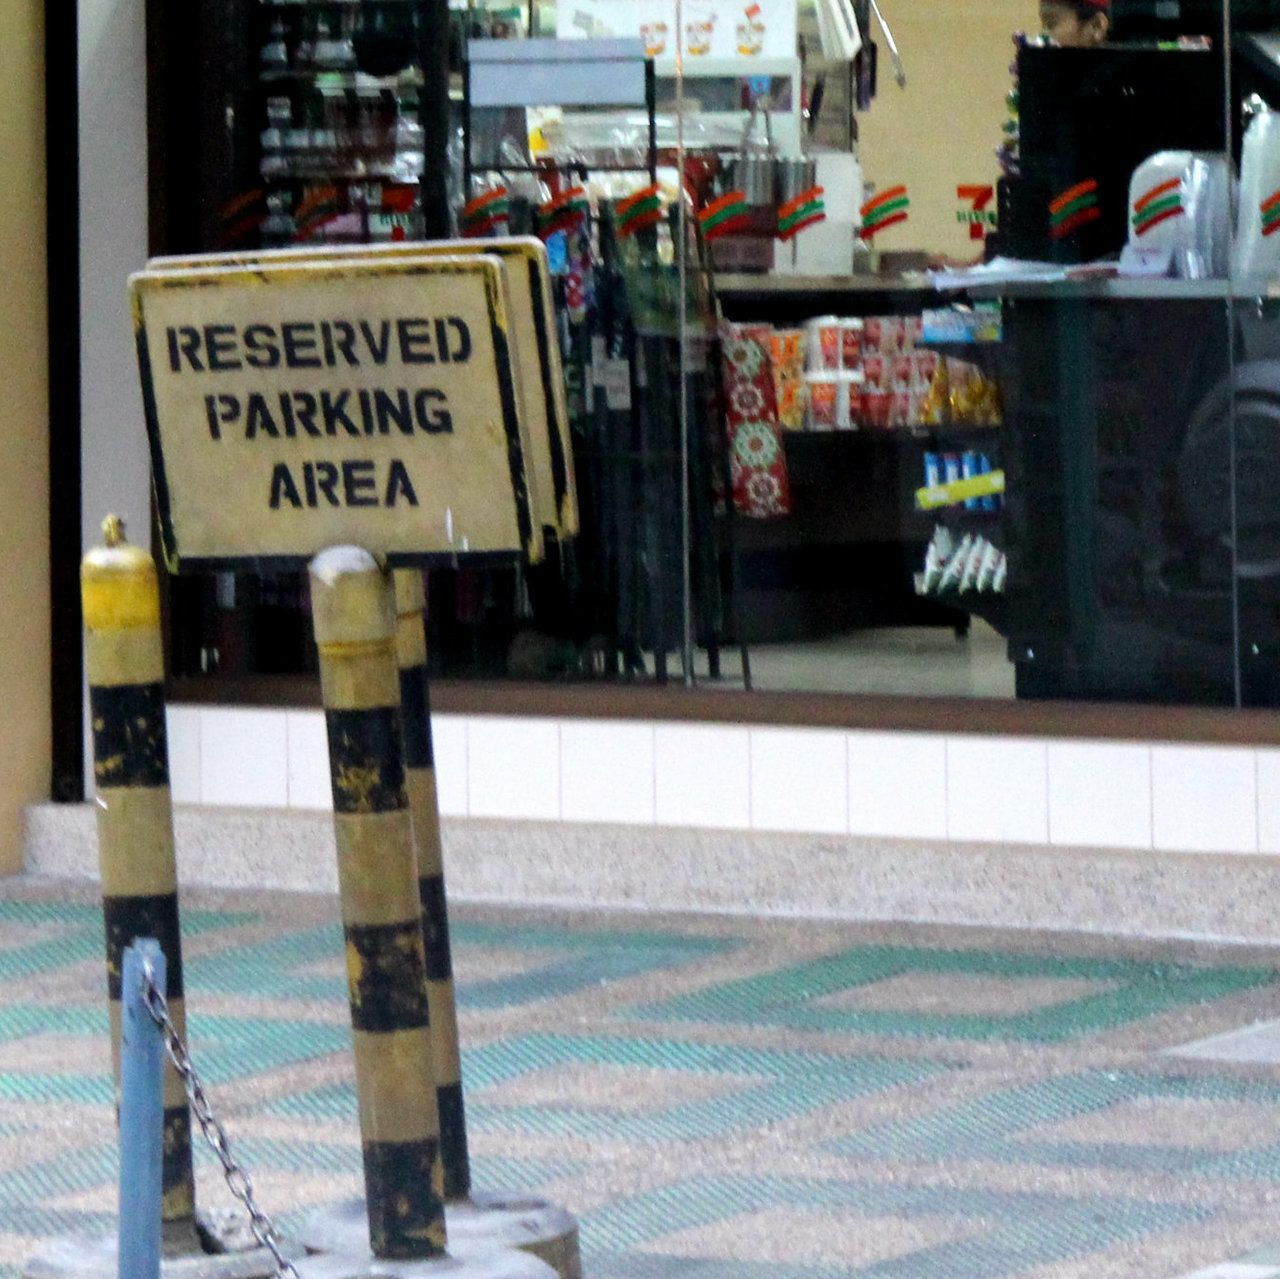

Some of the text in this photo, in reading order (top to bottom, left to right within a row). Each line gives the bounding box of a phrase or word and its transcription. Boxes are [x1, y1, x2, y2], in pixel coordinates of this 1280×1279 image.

[167, 316, 472, 372] RESERVED
[204, 388, 453, 440] PARKING
[269, 459, 419, 509] AREA
